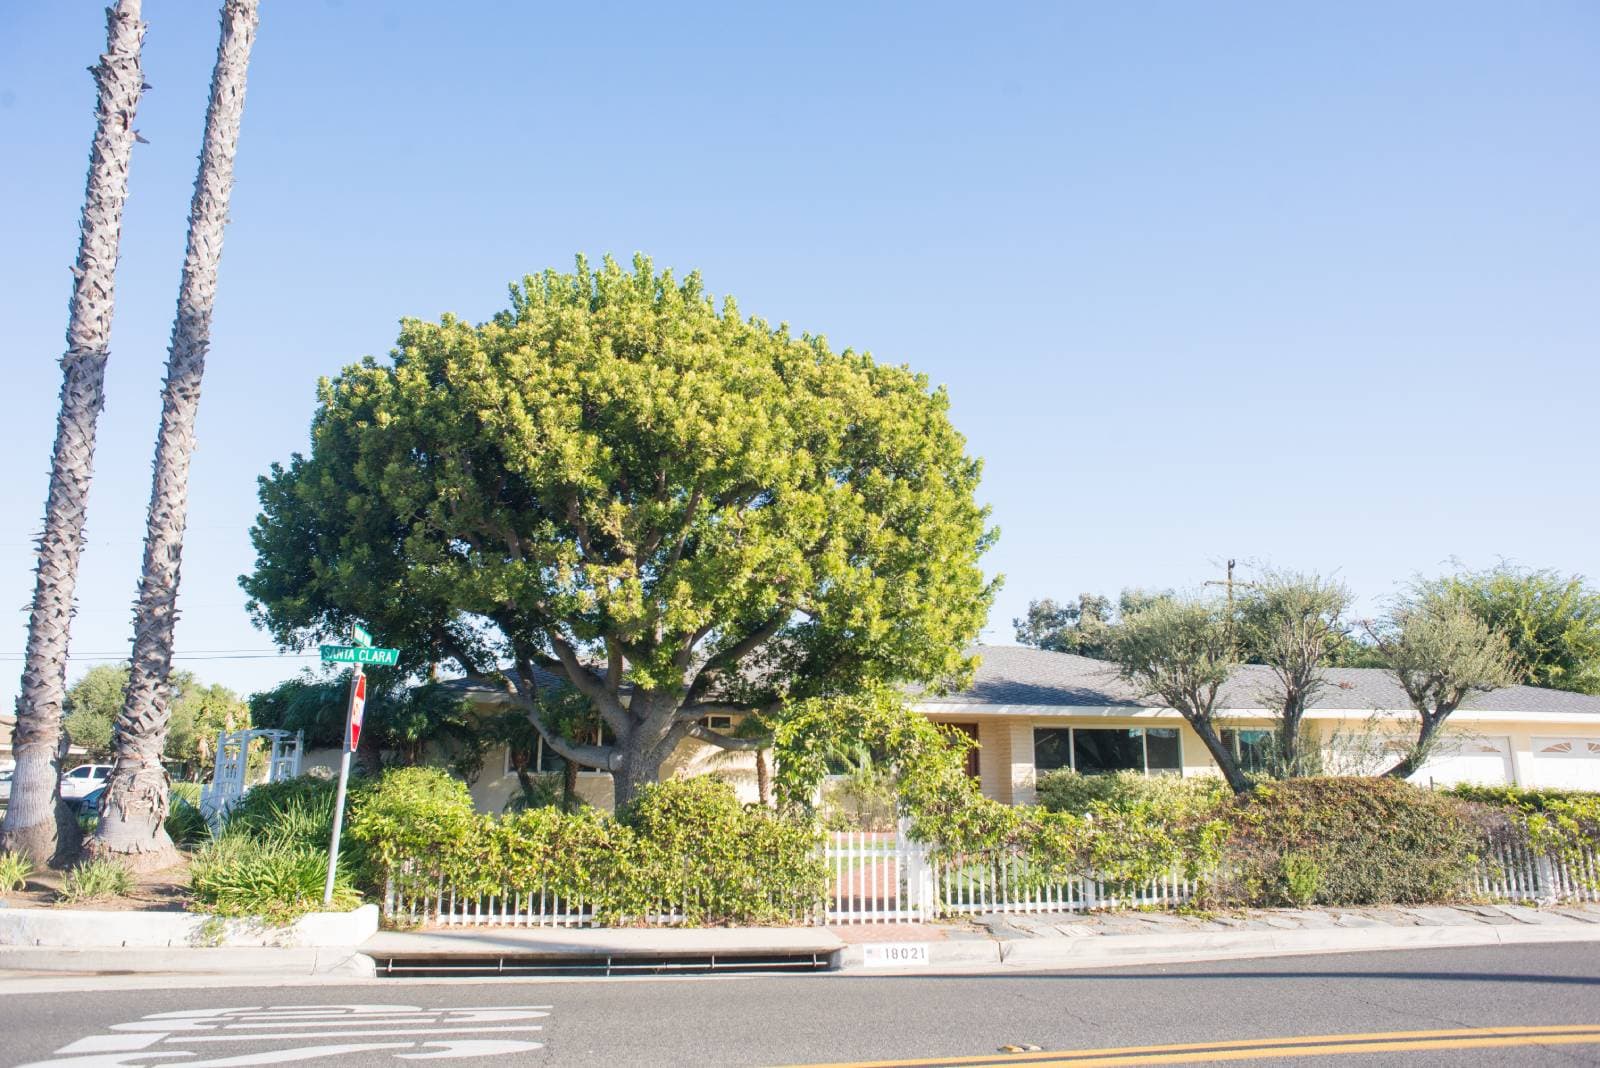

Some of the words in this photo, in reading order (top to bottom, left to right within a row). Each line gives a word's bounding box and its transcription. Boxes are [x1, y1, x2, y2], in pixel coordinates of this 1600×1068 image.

[323, 646, 354, 660] SANTA
[359, 649, 392, 663] CLARA
[885, 947, 925, 960] 18021
[13, 1004, 554, 1068] STOP
